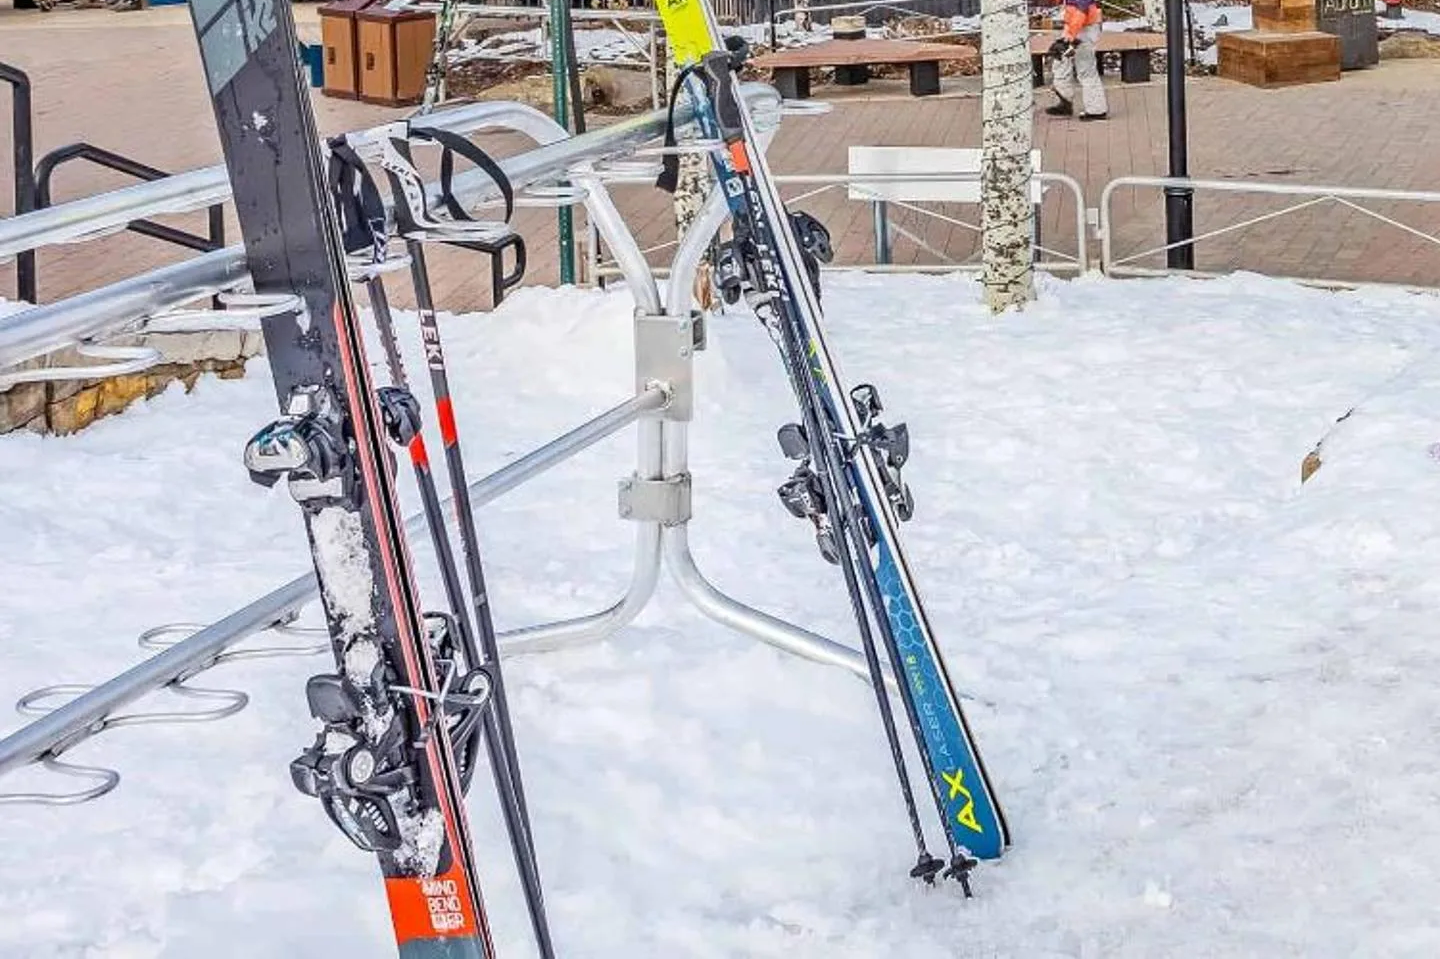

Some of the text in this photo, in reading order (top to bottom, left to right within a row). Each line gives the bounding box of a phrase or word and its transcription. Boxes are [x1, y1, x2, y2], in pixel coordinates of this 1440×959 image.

[420, 309, 443, 370] LEKI
[923, 702, 955, 771] LASER
[942, 768, 983, 834] AX
[428, 896, 462, 914] BEND
